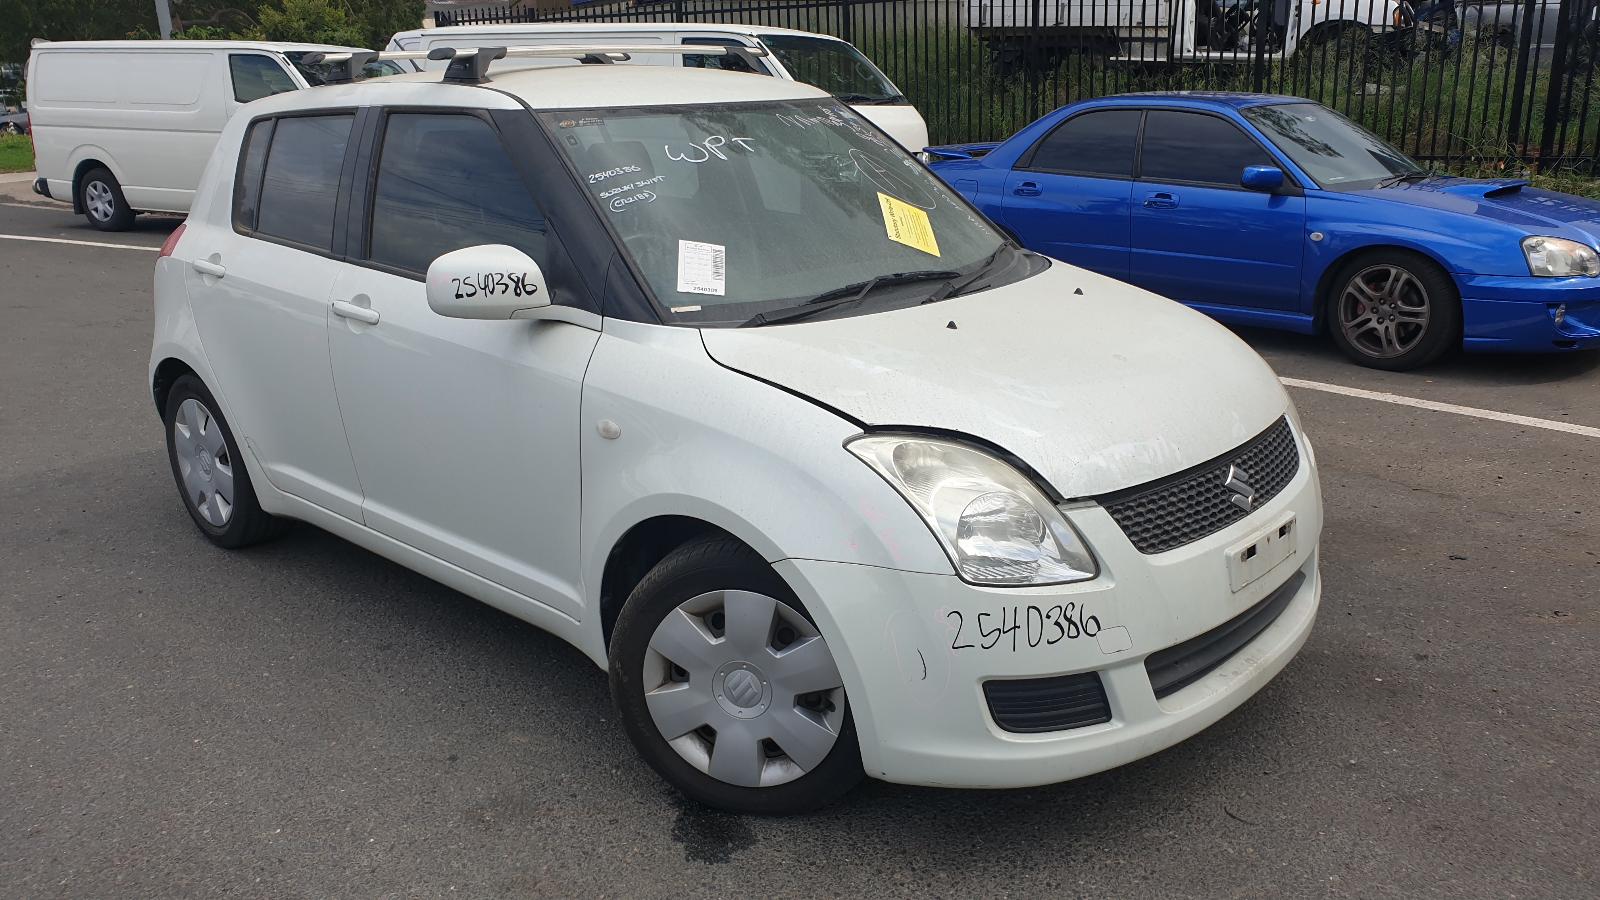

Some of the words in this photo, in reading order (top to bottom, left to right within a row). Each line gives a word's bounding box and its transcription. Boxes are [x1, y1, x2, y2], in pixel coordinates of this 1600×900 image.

[665, 135, 755, 163] WPT
[452, 272, 538, 299] 2540386
[946, 601, 1101, 652] 2540386
